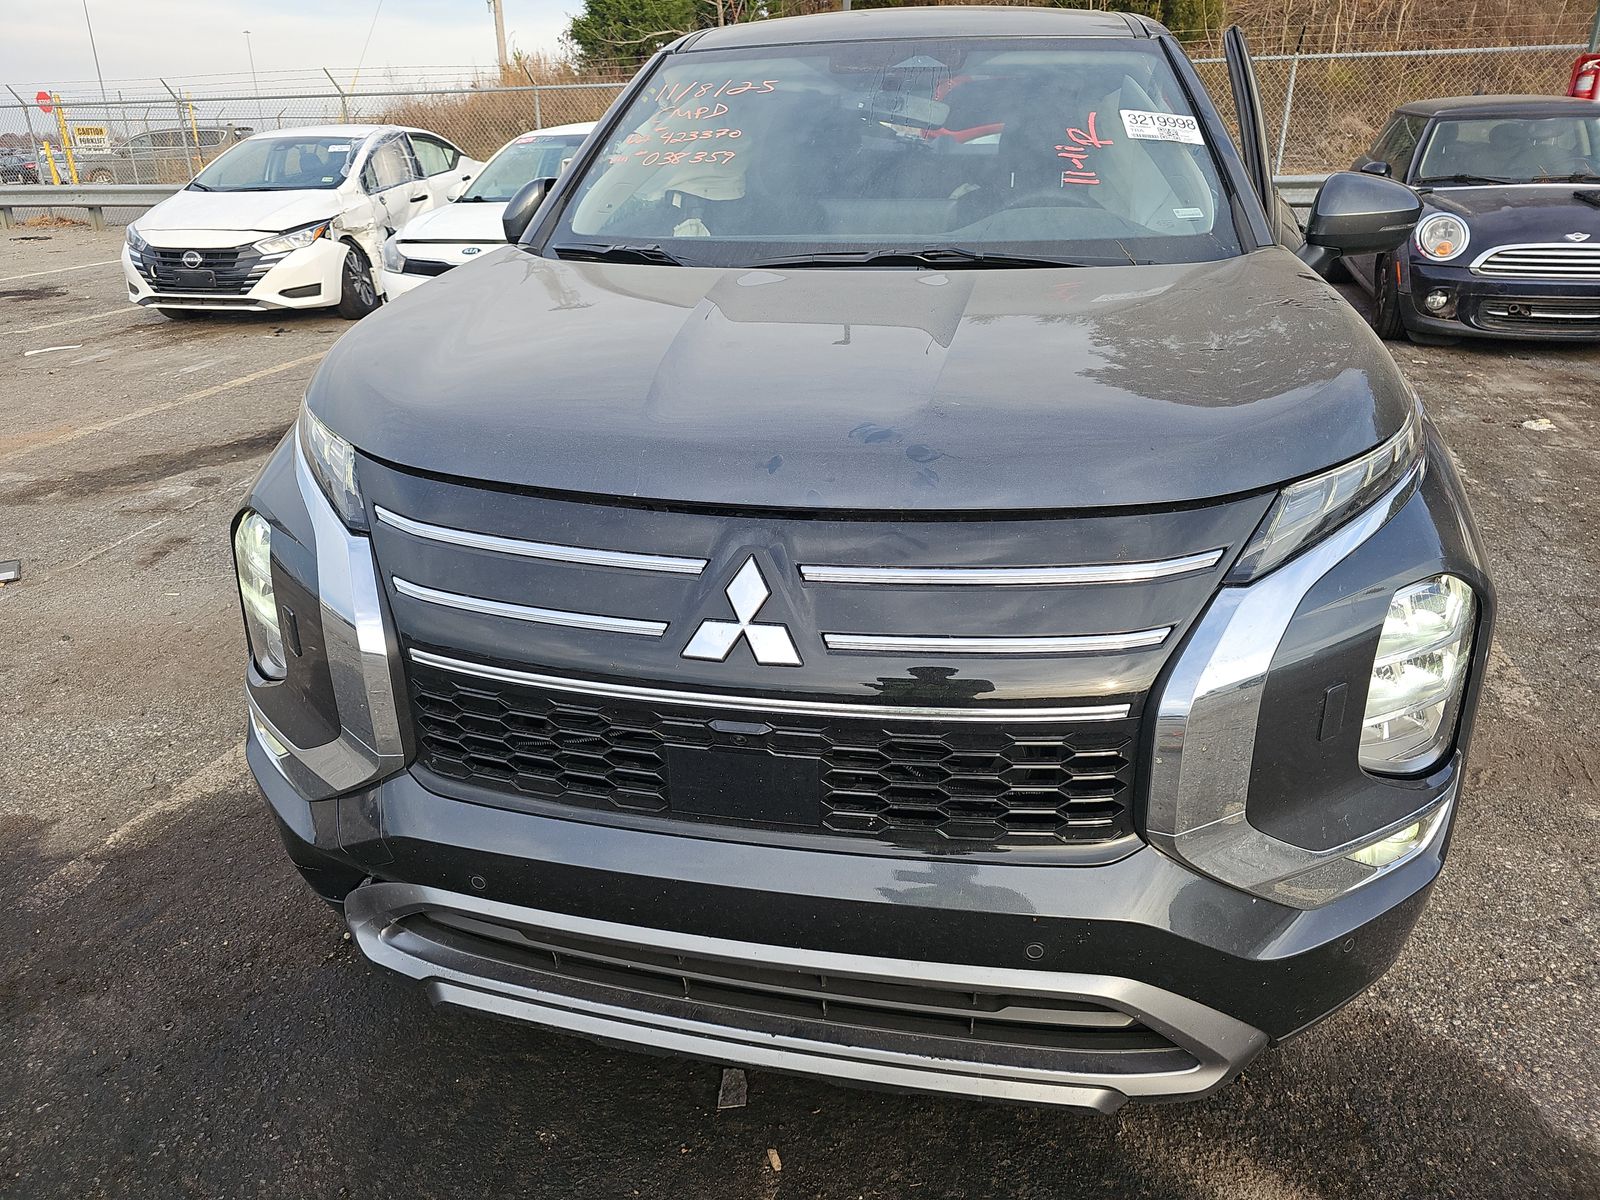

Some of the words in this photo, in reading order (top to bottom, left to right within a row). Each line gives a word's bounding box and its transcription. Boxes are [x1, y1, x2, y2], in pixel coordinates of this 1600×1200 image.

[655, 79, 779, 103] 11/8/25
[1127, 113, 1196, 131] 3219998
[77, 127, 104, 136] CAUTION
[79, 137, 106, 145] FORKLIFT
